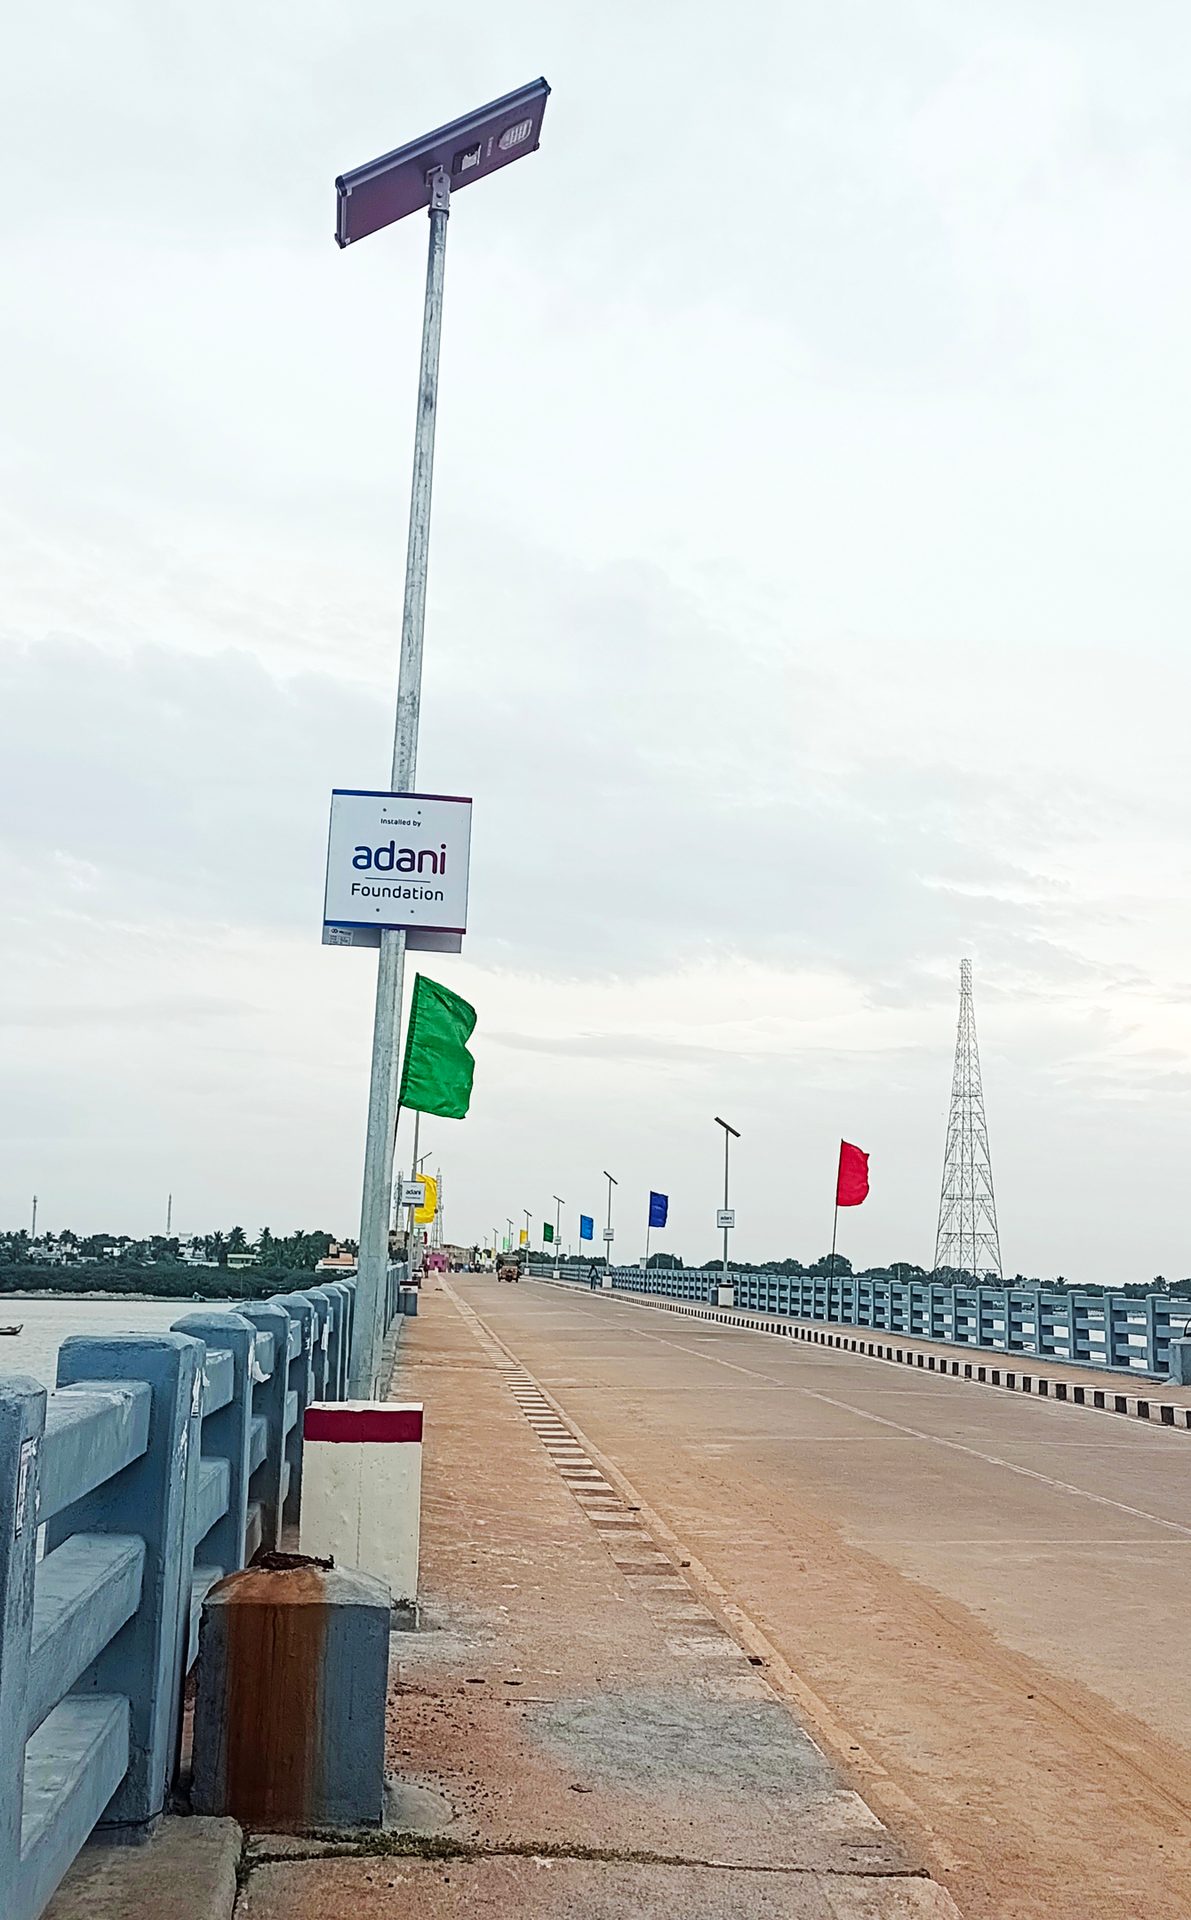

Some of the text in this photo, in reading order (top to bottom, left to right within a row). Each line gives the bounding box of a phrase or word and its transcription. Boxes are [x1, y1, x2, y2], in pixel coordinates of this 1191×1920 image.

[380, 818, 421, 827] Installed by
[352, 840, 446, 875] adani
[351, 883, 444, 901] Foundation
